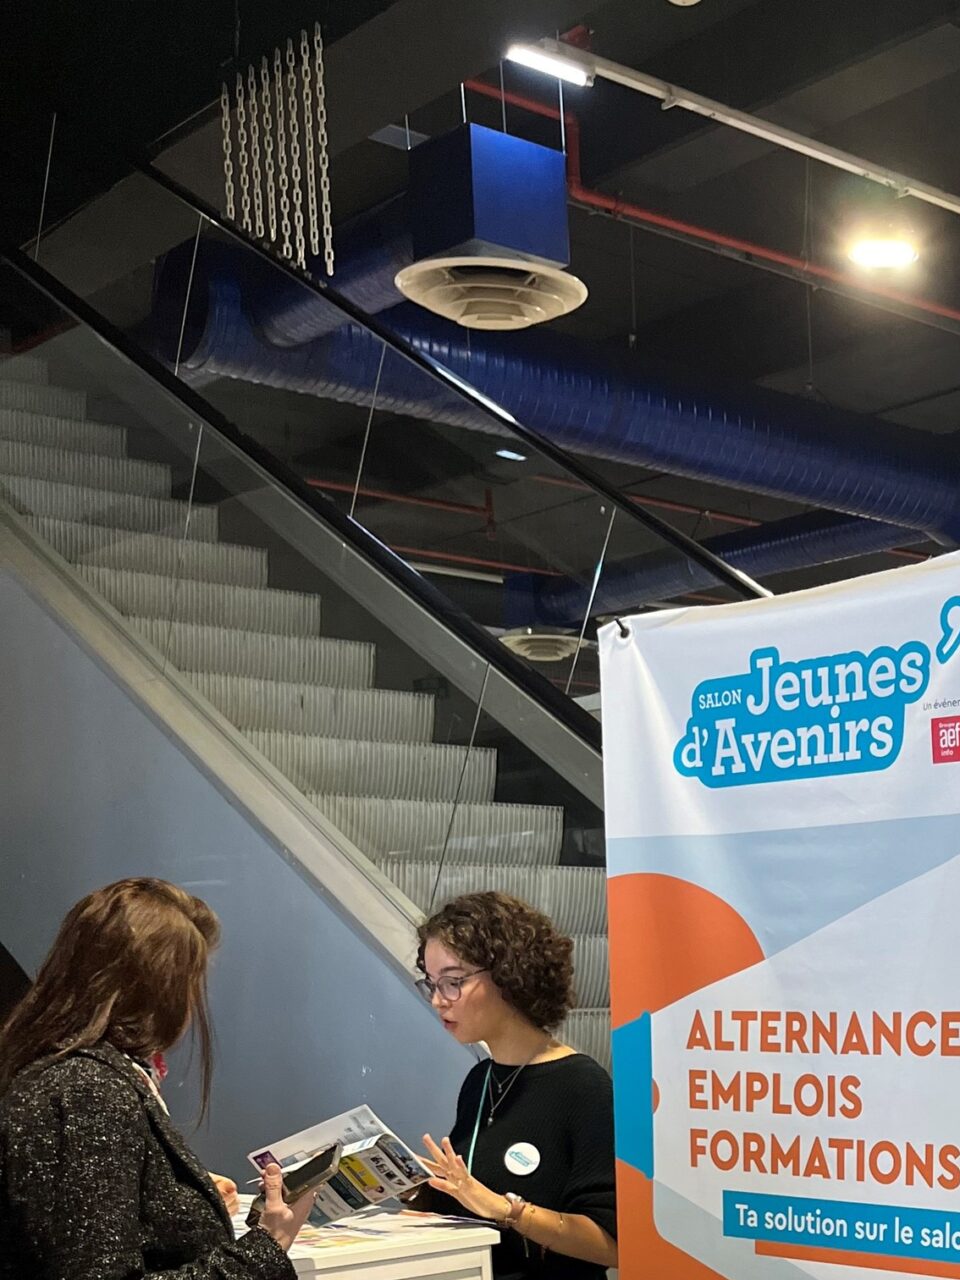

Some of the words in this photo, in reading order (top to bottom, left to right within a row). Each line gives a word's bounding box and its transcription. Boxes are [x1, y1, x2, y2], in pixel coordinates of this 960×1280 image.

[698, 689, 742, 709] SALON
[746, 654, 924, 716] Jeunes
[922, 703, 932, 711] Un
[681, 704, 894, 777] d'Avenirs
[939, 721, 960, 748] aef
[940, 748, 954, 757] info
[688, 1068, 863, 1119] EMPLOIS
[735, 1203, 758, 1228] Ta
[764, 1207, 848, 1238] solution
[855, 1220, 887, 1242] sur
[894, 1217, 914, 1245] le
